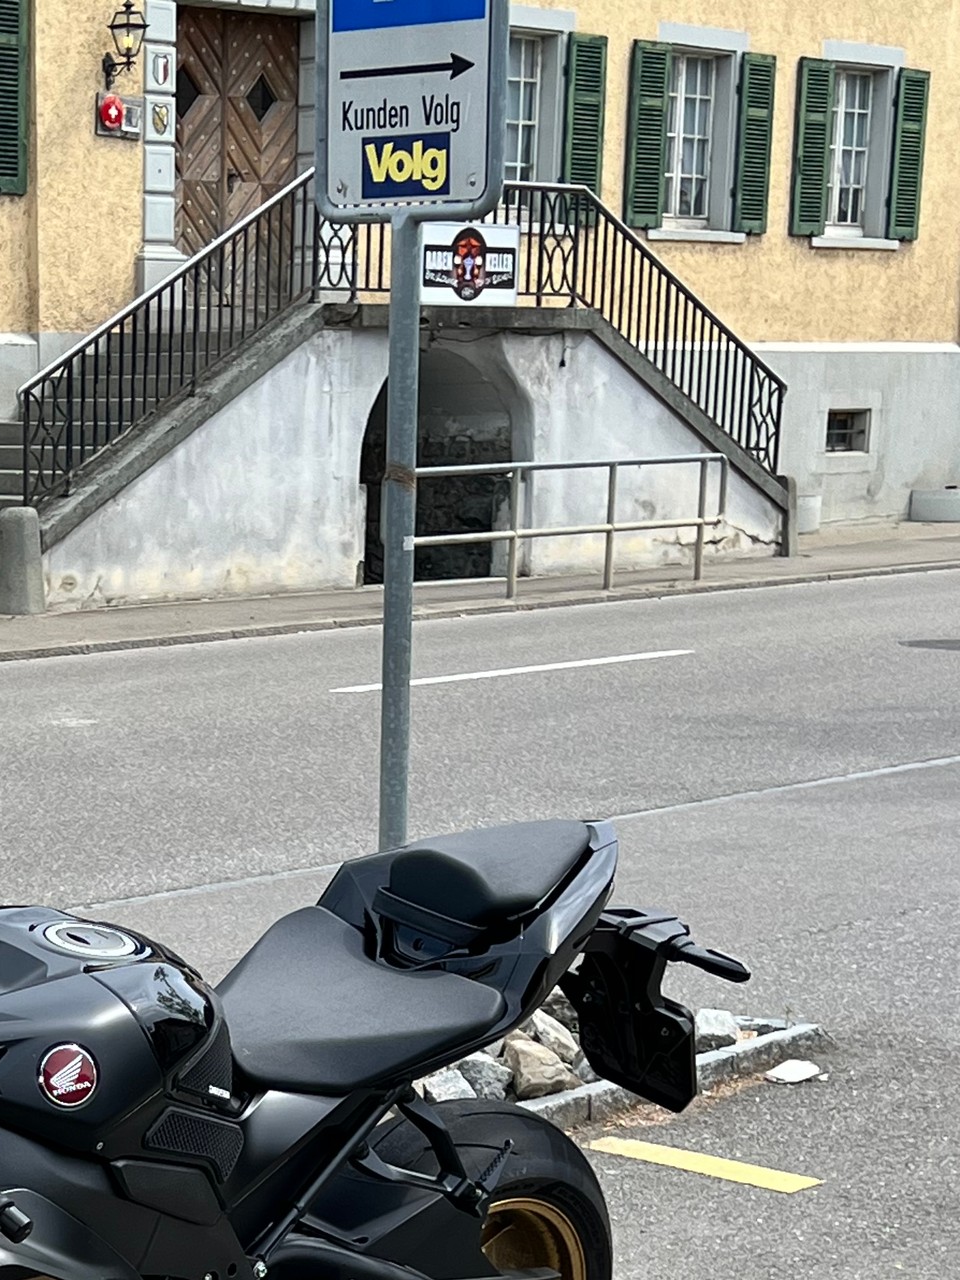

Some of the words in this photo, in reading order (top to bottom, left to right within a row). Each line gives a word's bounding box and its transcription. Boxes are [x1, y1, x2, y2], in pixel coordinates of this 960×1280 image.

[342, 98, 409, 131] Kunden
[422, 93, 461, 133] Volg
[364, 140, 447, 191] Volg
[52, 1081, 92, 1097] HONDA
